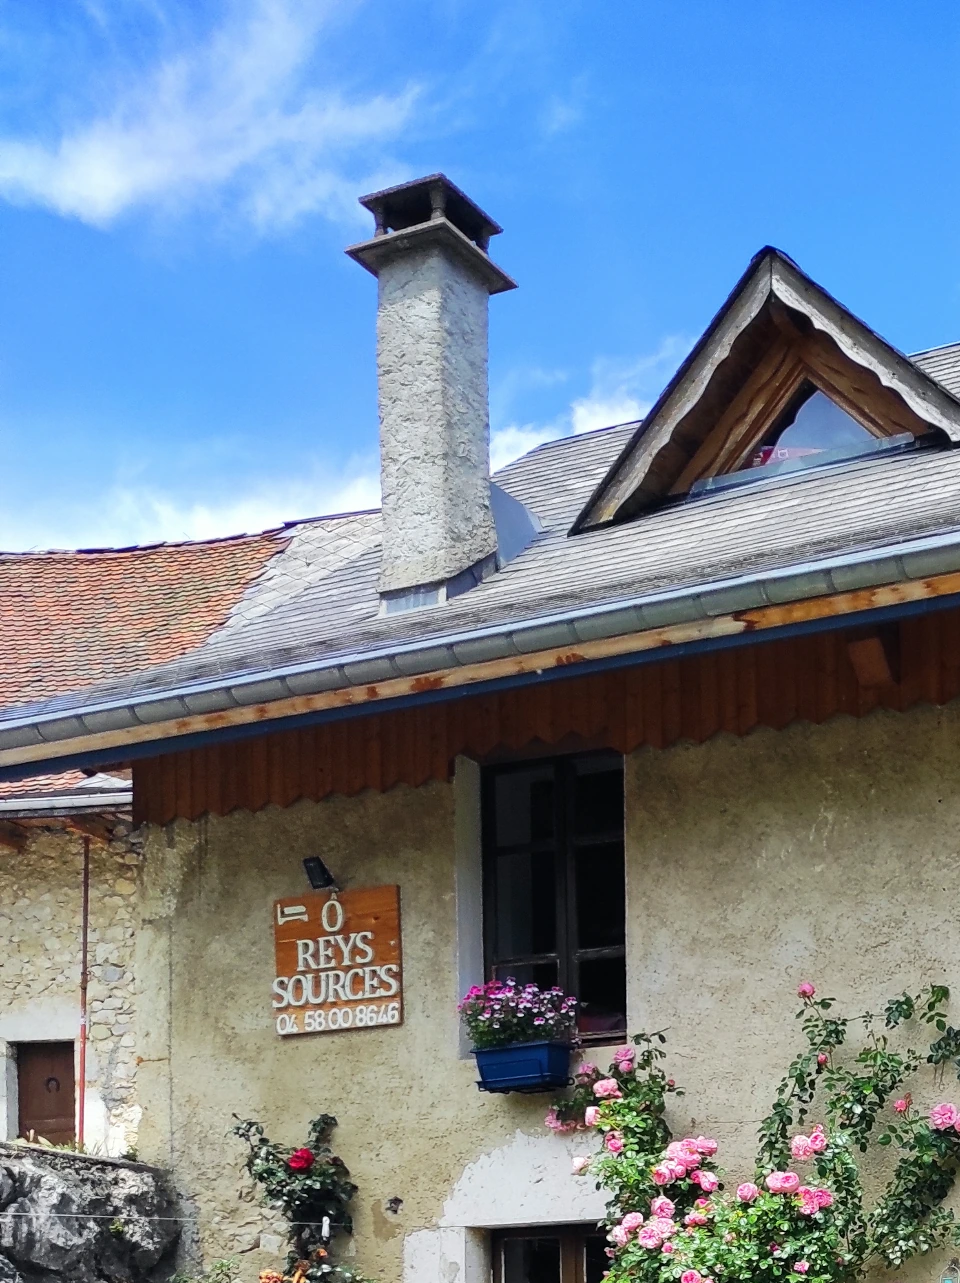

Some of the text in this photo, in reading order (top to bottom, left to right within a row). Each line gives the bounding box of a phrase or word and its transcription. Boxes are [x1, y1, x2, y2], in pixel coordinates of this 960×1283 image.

[296, 931, 373, 971] REYS
[272, 964, 399, 1008] SOURCES
[304, 1010, 326, 1031] 58
[328, 1007, 352, 1029] 00
